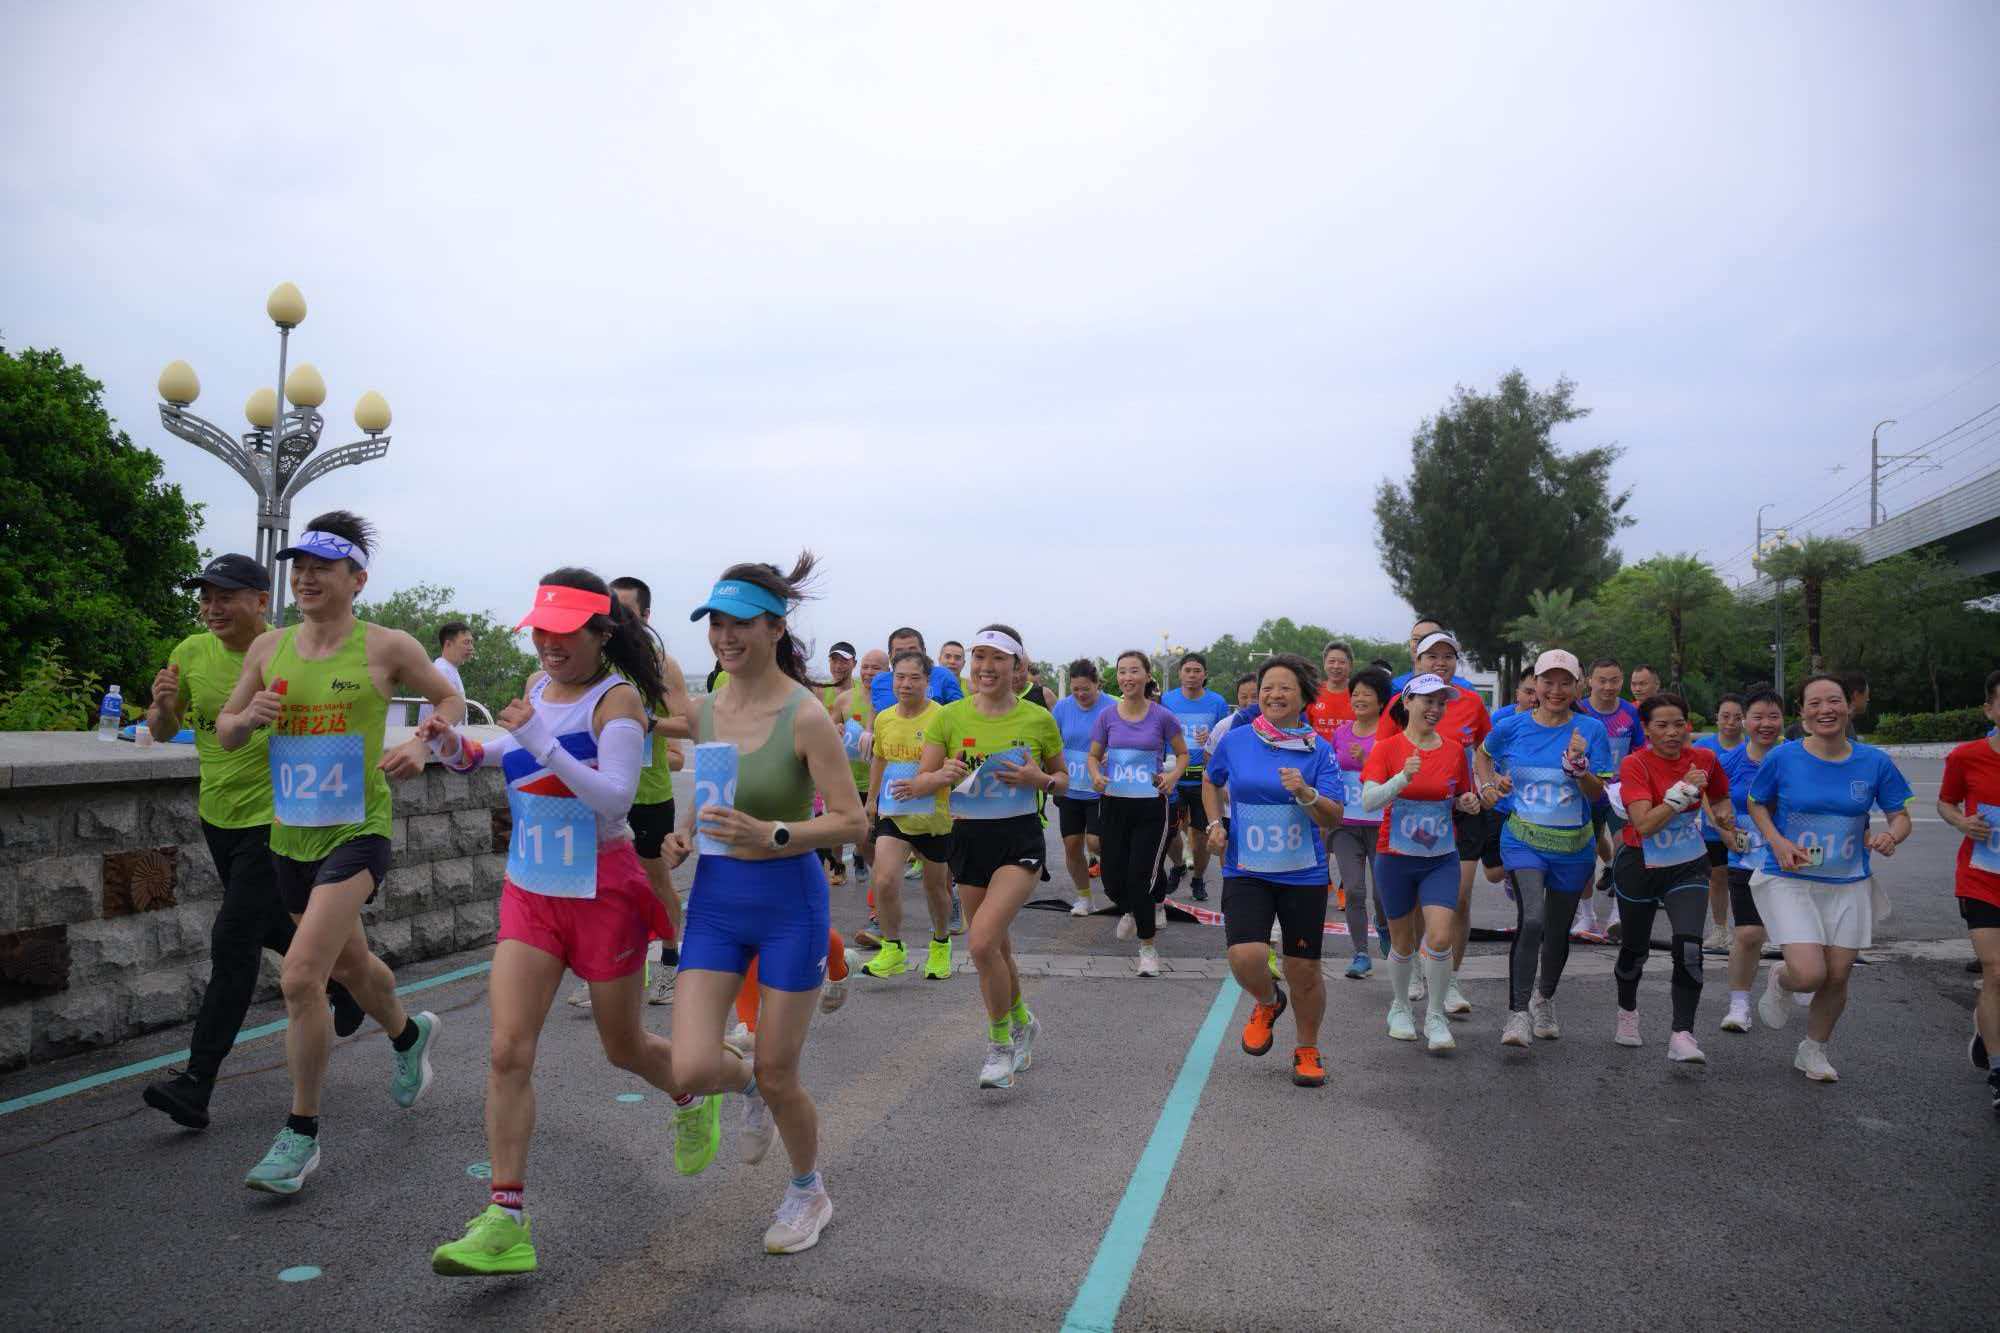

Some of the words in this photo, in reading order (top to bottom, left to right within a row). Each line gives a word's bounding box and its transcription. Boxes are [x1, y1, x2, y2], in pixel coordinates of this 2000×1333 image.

[280, 762, 348, 800] 024
[1113, 764, 1149, 784] 046
[518, 818, 574, 866] 011
[1246, 824, 1304, 853] 038
[1798, 831, 1856, 860] 016
